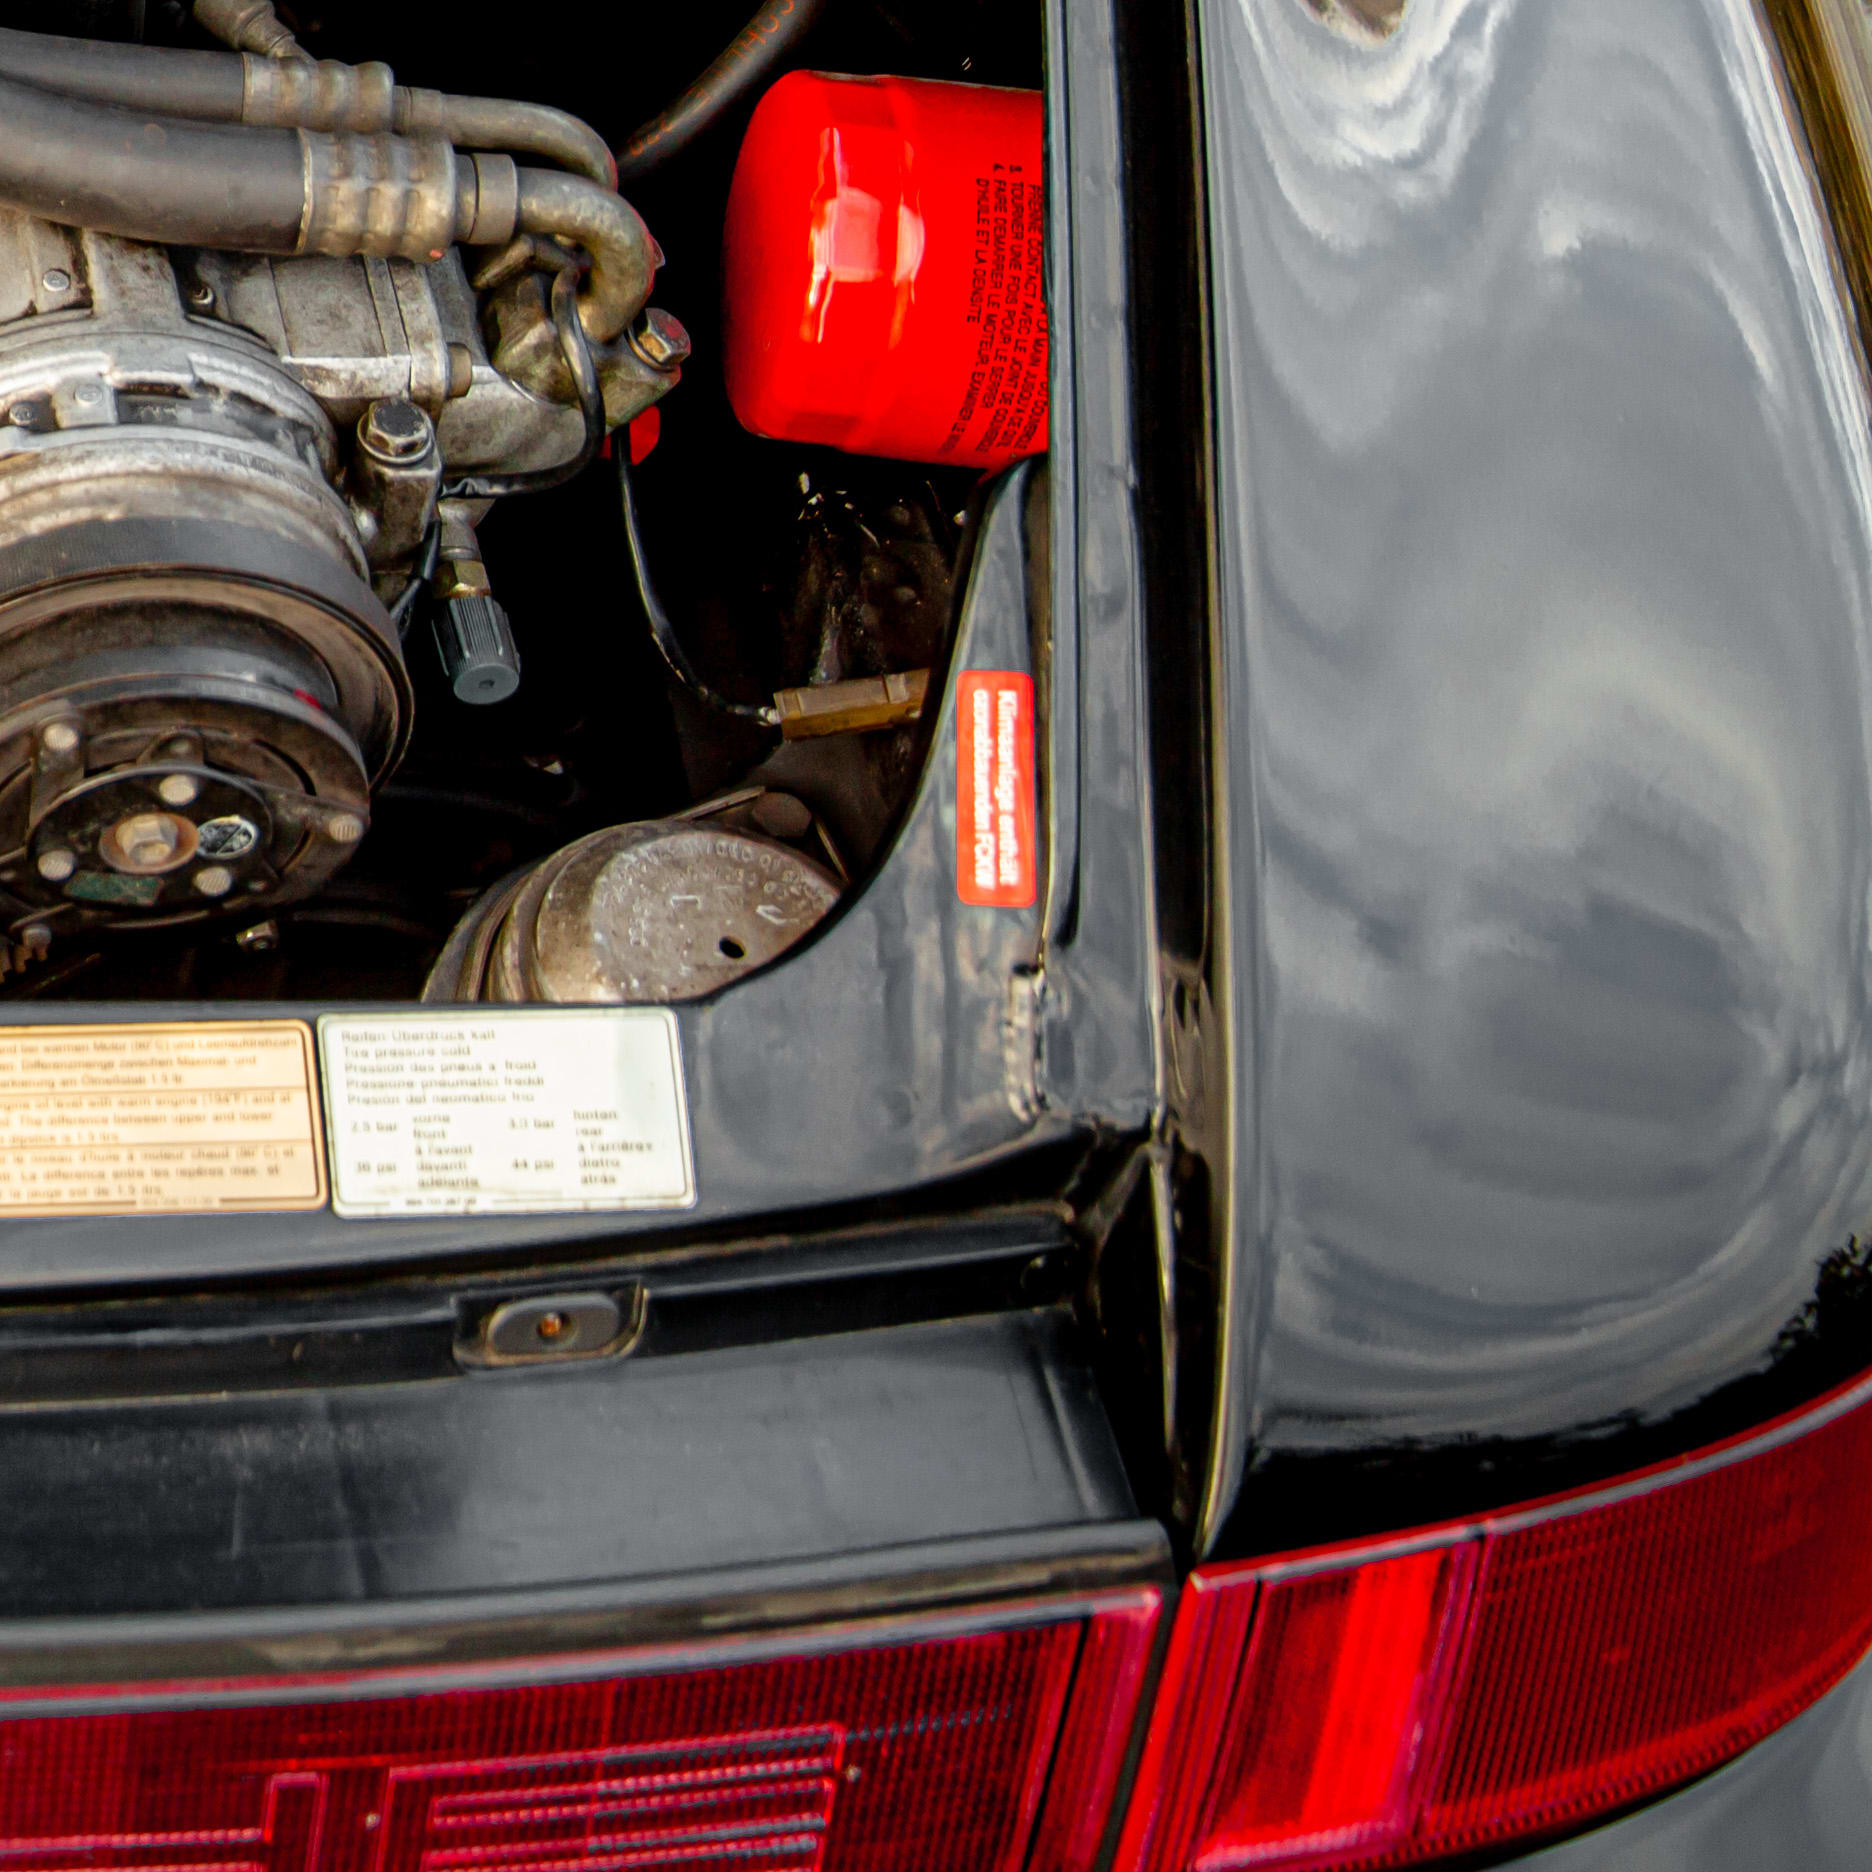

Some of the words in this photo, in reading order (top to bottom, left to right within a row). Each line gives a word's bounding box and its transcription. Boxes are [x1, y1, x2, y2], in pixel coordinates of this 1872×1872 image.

[976, 230, 989, 246] ET
[975, 250, 987, 264] LA
[1009, 244, 1022, 271] UNE
[1024, 238, 1042, 299] CONTACT
[987, 294, 1000, 309] LE
[1005, 276, 1020, 304] FOIS
[1000, 310, 1016, 344] POUR
[1018, 302, 1034, 334] AVEC
[994, 348, 1007, 362] LE
[1014, 339, 1028, 352] LE
[993, 689, 1019, 812] Klimaanlage
